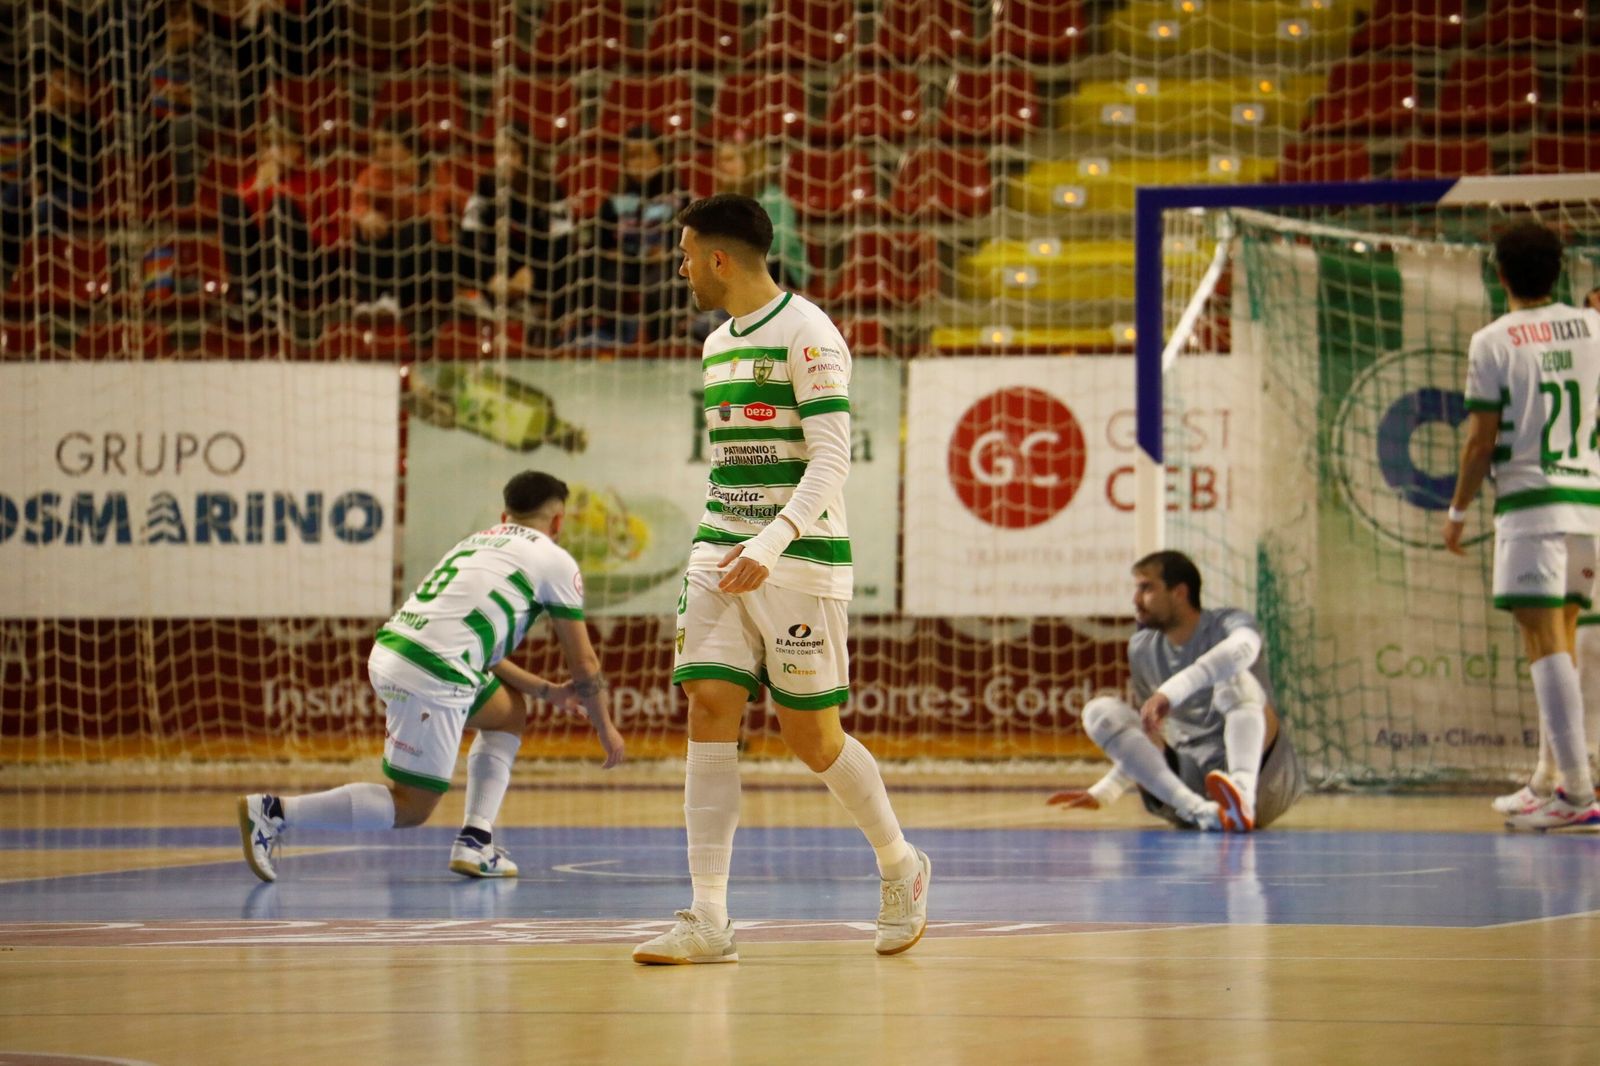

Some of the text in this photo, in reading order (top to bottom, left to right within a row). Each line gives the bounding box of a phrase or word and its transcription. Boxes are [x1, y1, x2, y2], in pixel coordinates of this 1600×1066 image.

[746, 407, 773, 416] Deza
[1539, 379, 1581, 463] 21
[56, 431, 246, 476] GRUPO
[723, 445, 770, 455] PATRIMONIO
[724, 454, 779, 466] HUMANIDAD
[969, 430, 1061, 488] GC
[722, 503, 779, 518] atedral
[416, 549, 477, 602] 6
[785, 639, 824, 648] Arcángel
[1445, 728, 1506, 747] Clima
